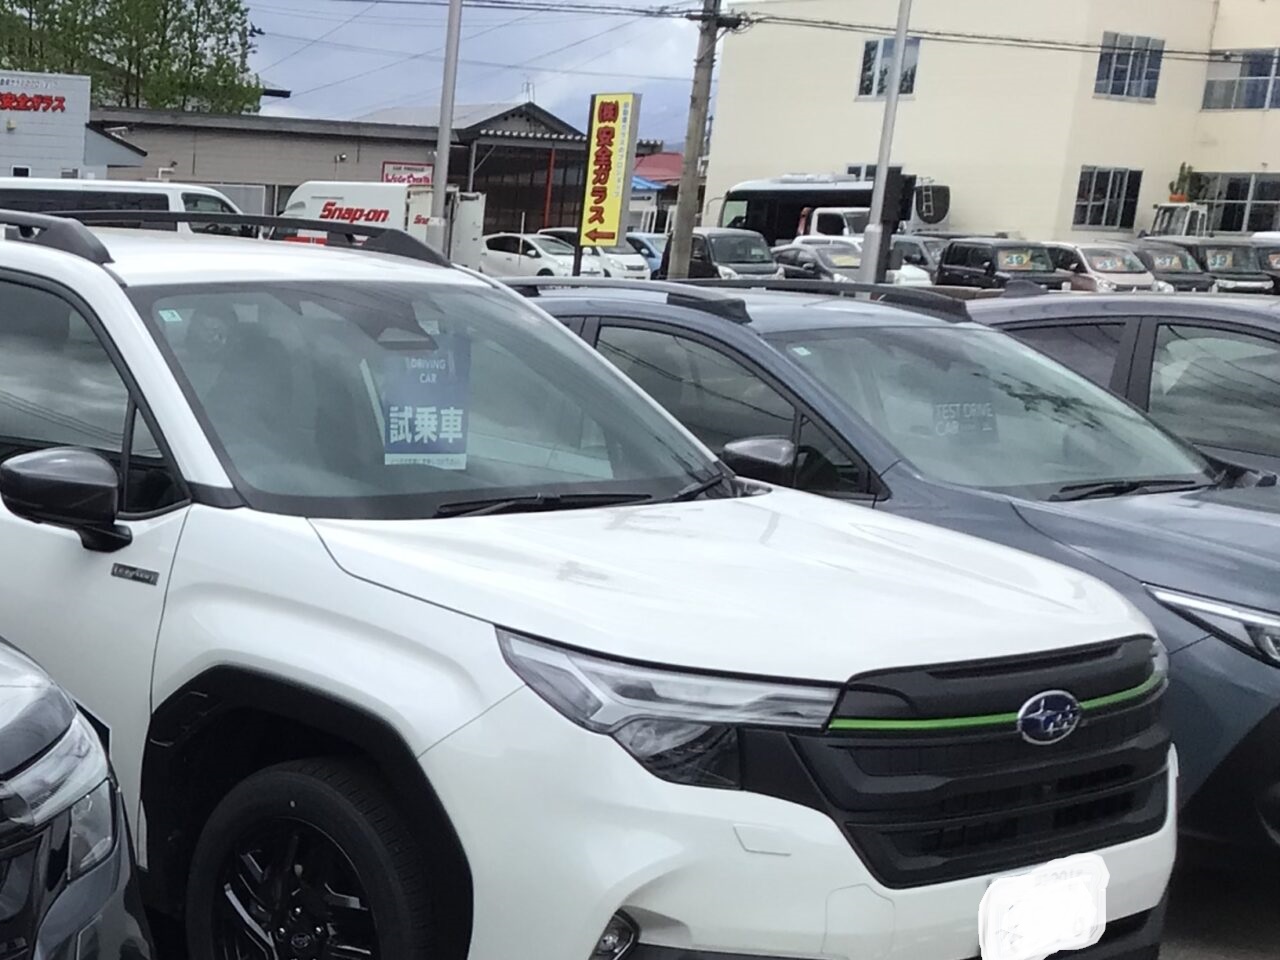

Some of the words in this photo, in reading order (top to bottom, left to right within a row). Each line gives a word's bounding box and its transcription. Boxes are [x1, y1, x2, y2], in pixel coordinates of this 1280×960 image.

[320, 201, 390, 224] Snap-on
[389, 405, 464, 444] 試乗車
